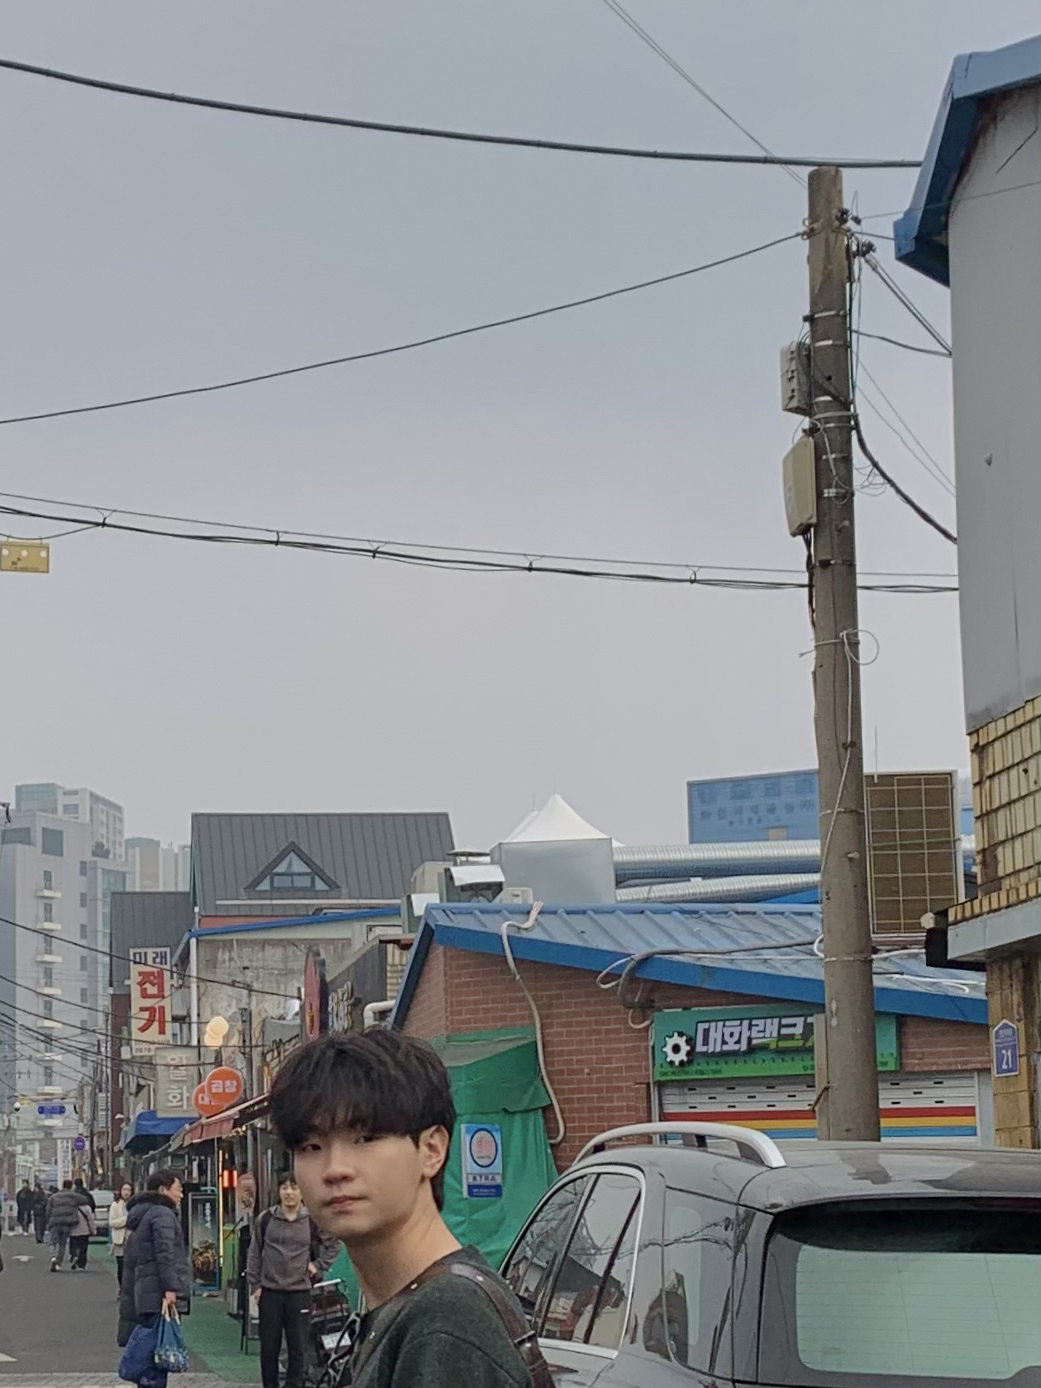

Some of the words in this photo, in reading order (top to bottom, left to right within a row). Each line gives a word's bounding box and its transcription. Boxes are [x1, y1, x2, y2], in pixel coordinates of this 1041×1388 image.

[133, 952, 168, 966] 미래
[137, 969, 166, 1035] 전기
[1002, 1049, 1012, 1070] 21
